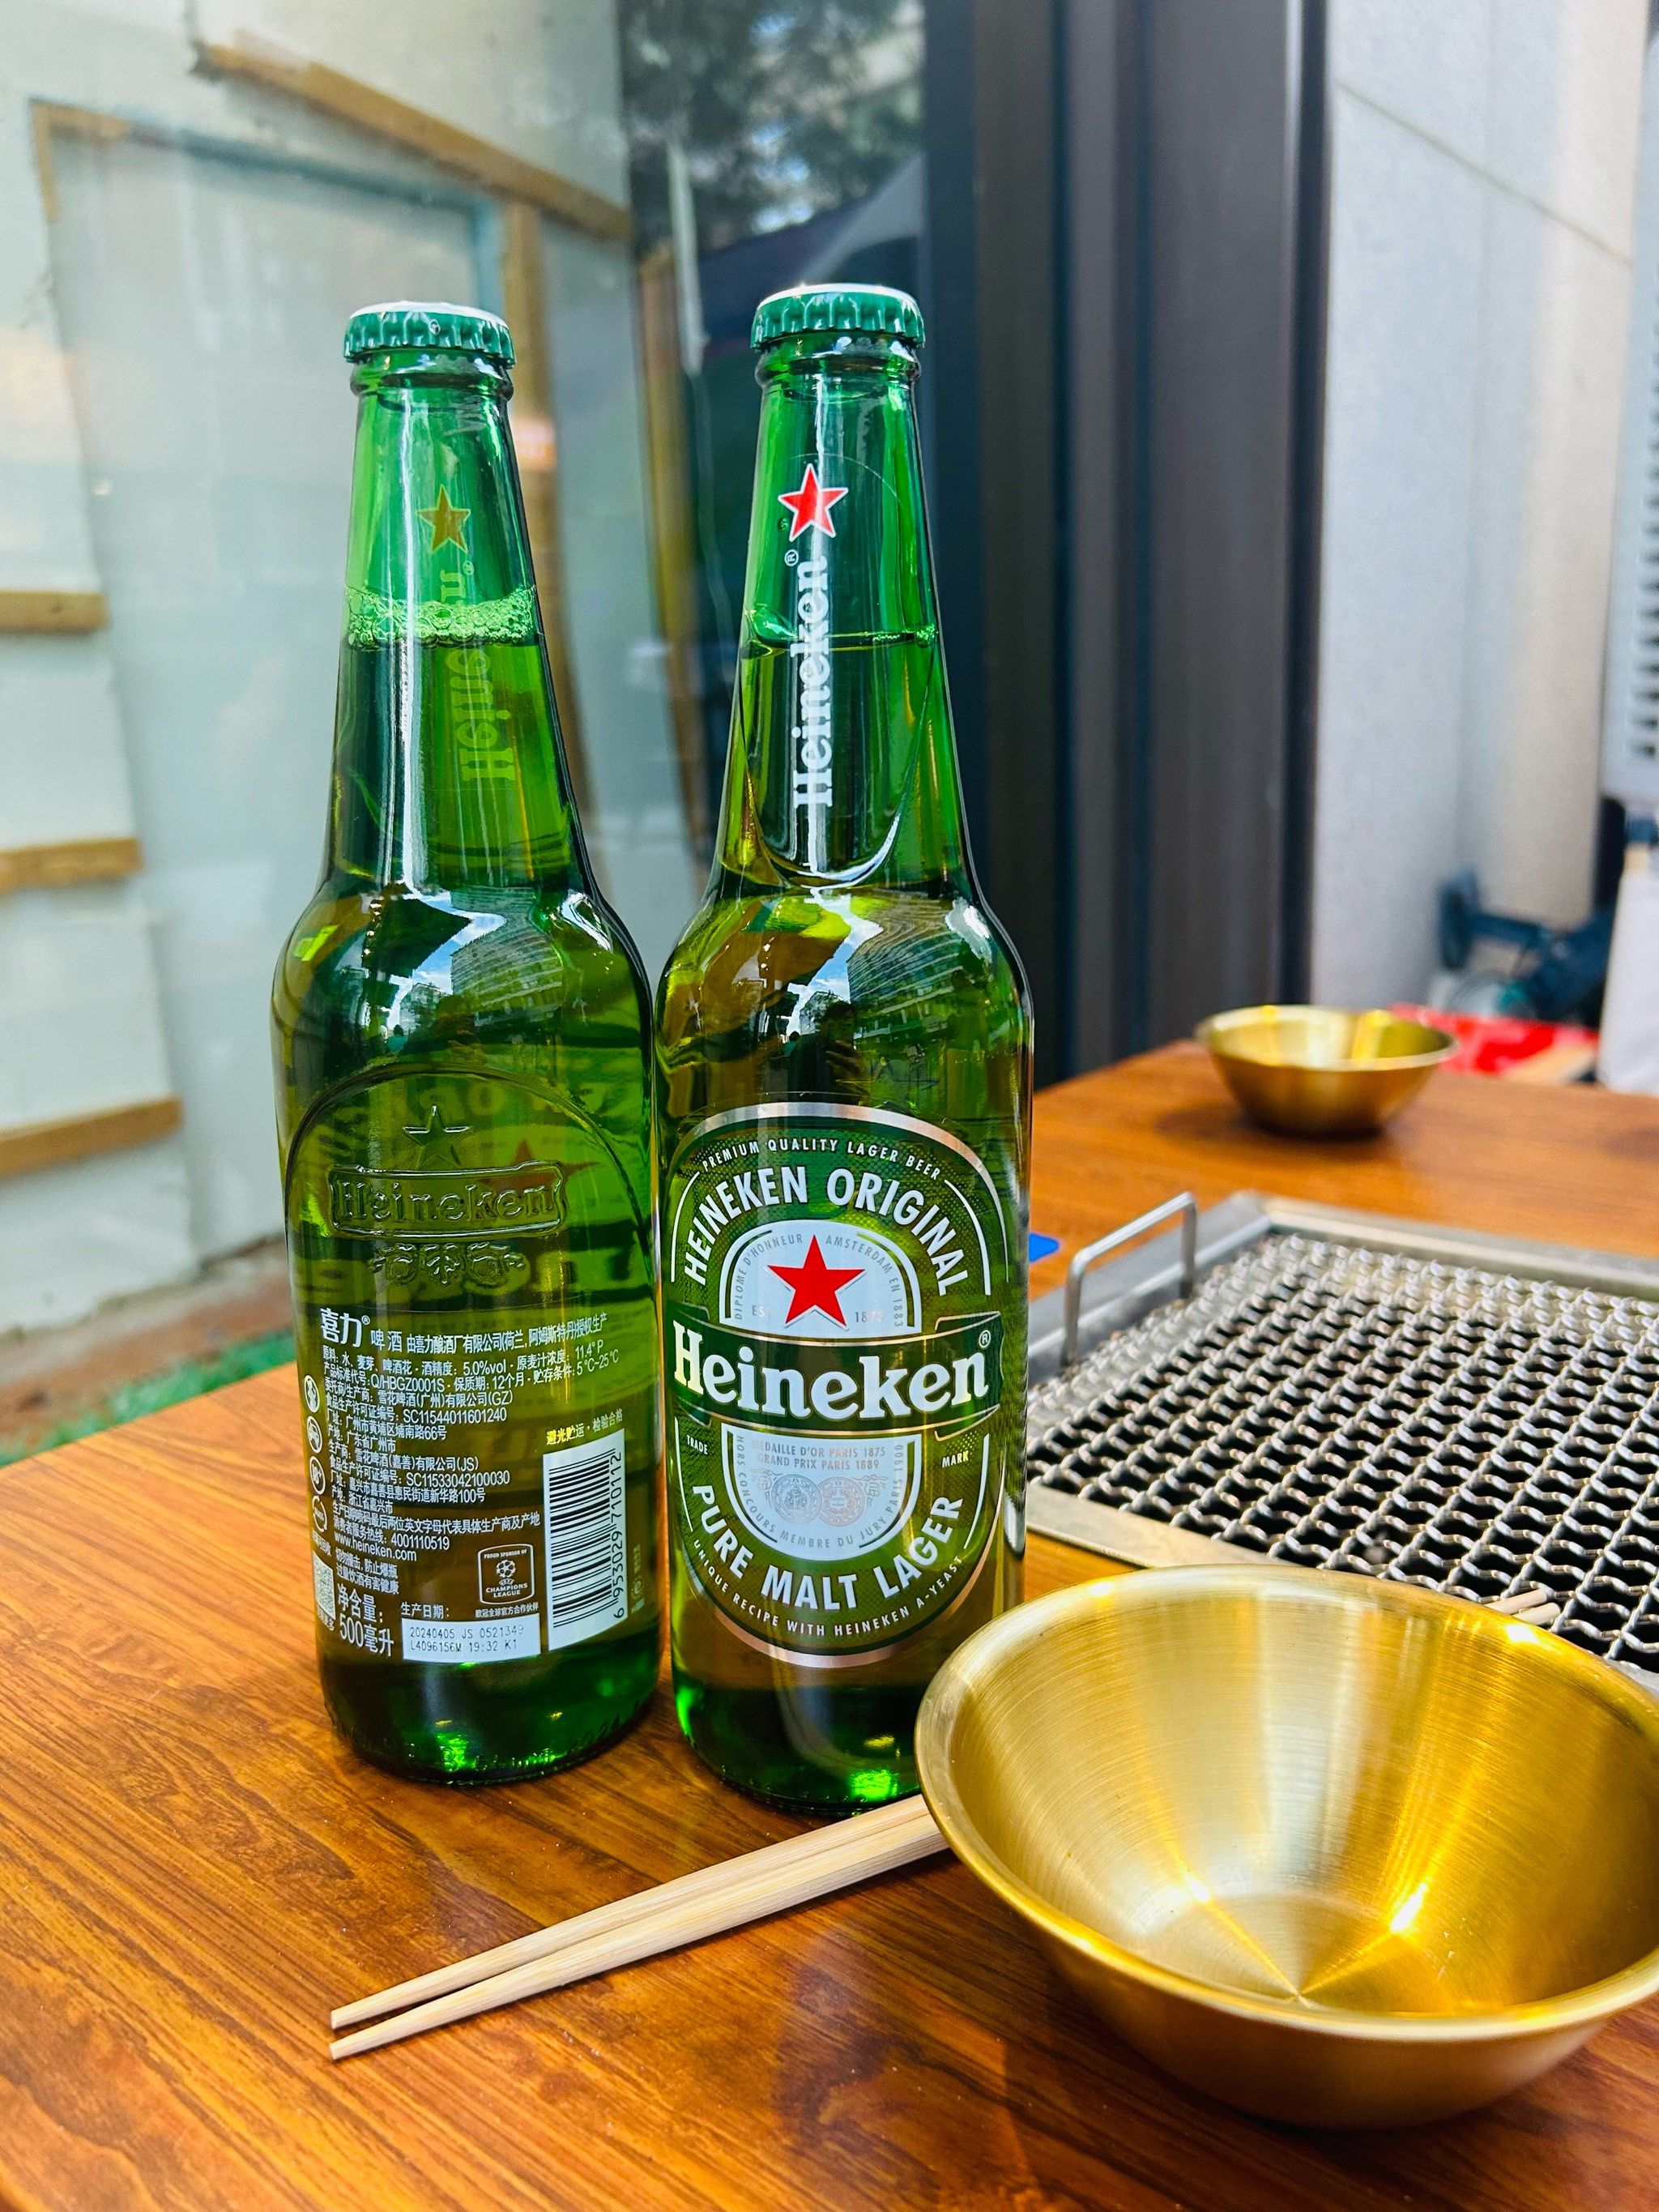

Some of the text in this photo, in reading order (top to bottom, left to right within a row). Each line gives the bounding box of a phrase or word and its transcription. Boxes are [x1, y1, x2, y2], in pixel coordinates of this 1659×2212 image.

[702, 1138, 941, 1181] PREMIUM QUALITY LAGER BEER
[339, 1181, 554, 1223] Heineken
[684, 1165, 970, 1296] HEINEKEN ORIGINAL
[825, 1235, 893, 1274] AMSTERDAM
[735, 1268, 747, 1320] DIPLOME
[889, 1278, 900, 1292] EN
[893, 1298, 903, 1327] 1883
[686, 1434, 970, 1468] TRADE MARK
[794, 1458, 817, 1470] PRIX
[821, 1459, 851, 1470] PARIS
[855, 1459, 880, 1469] 1889
[830, 1446, 858, 1458] PARIS
[864, 1446, 886, 1457] 1875
[736, 1436, 903, 1548] HORS CONCOURS MEMBRE DU JURY PARIS 1900
[333, 1531, 417, 1562] www.heineken.com
[692, 1484, 964, 1611] PURE MALT LAGER
[485, 1582, 528, 1593] CHAMPIONS
[493, 1590, 521, 1598] LEAGUE
[693, 1539, 962, 1637] UNIQUE RECIPE WITH HEINEKEN A-YEAST
[339, 1613, 394, 1657] 500毫升
[410, 1626, 455, 1638] 20240405
[462, 1629, 473, 1638] JS
[469, 1640, 498, 1652] 19:32
